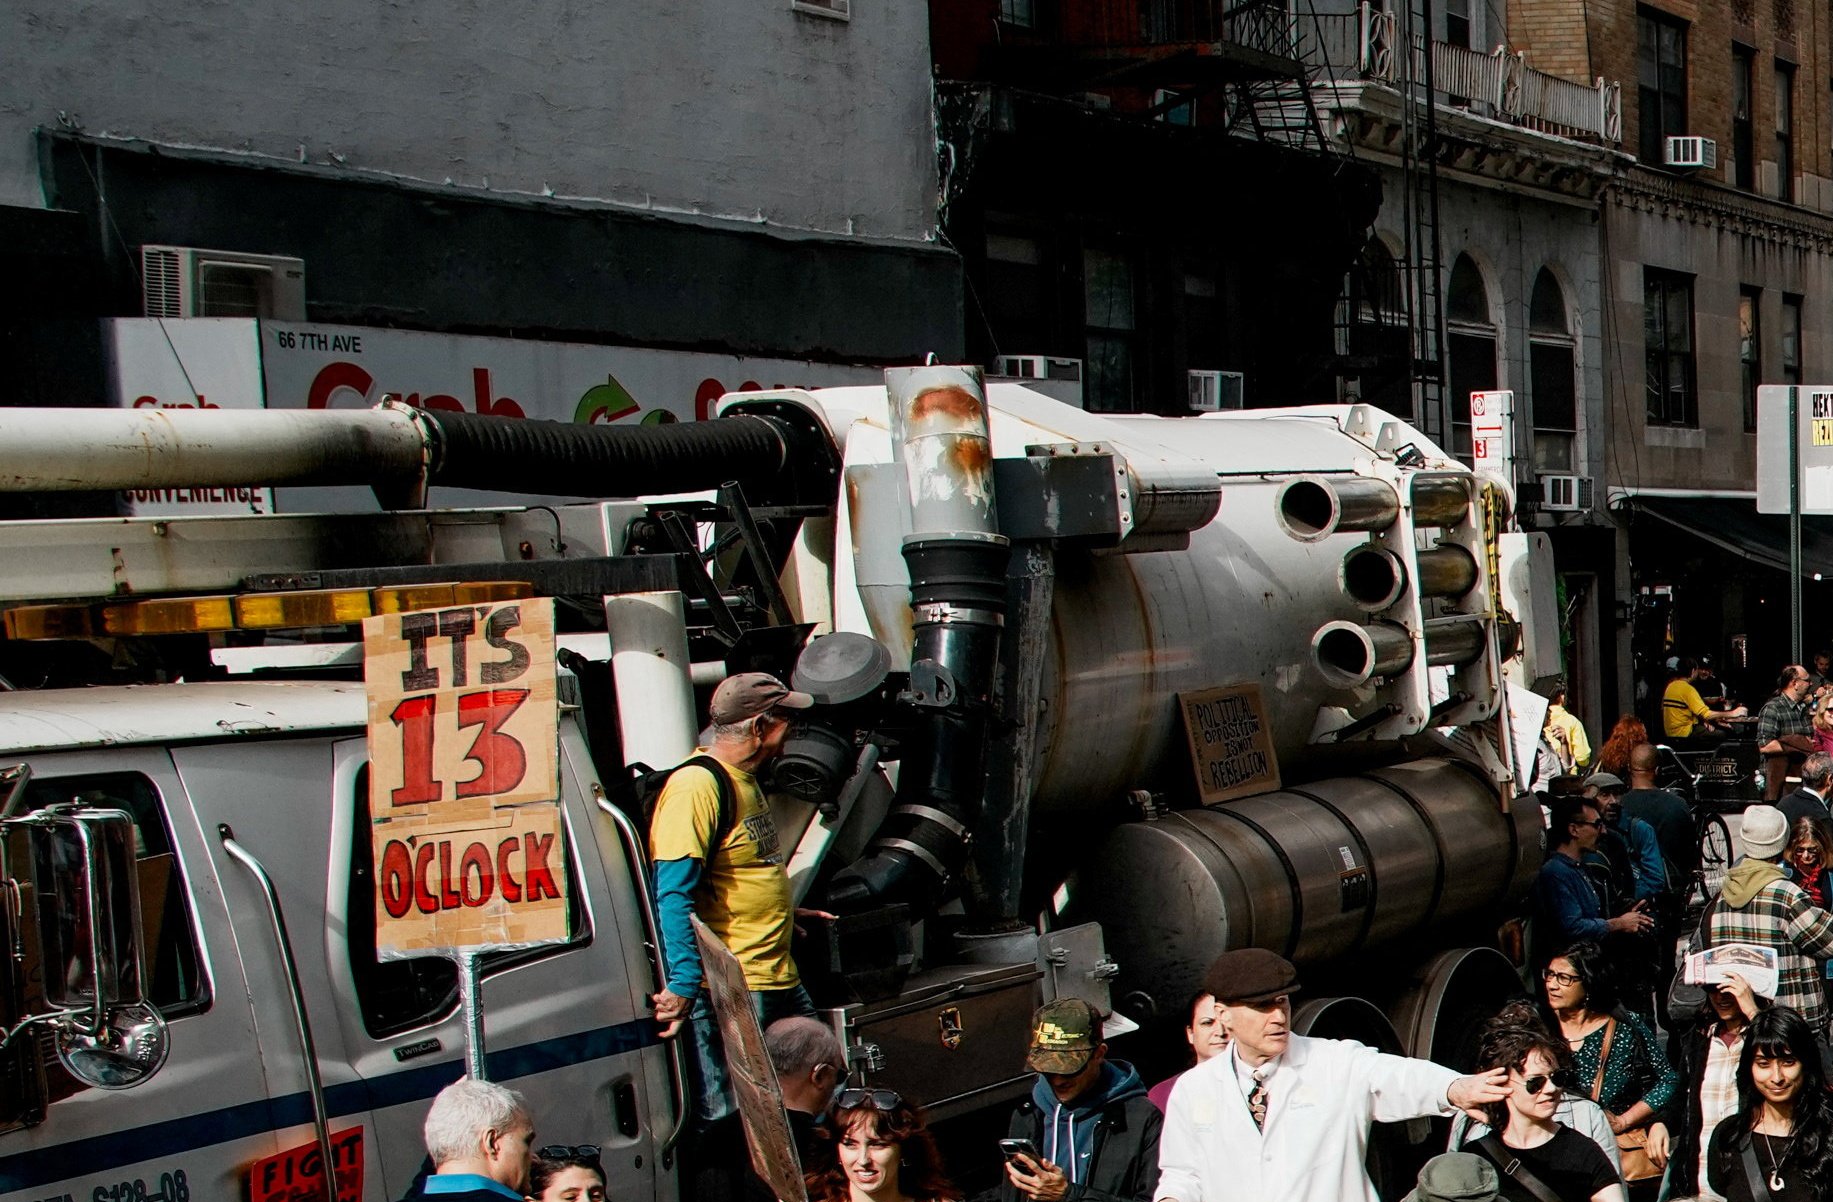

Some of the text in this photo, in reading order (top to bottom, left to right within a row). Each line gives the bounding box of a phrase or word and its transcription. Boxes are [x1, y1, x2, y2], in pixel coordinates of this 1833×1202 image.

[279, 331, 362, 353] 66 7TH AVE
[401, 605, 532, 692] IT'S
[1195, 695, 1258, 730] POLITICAL
[389, 688, 531, 807] 13
[1204, 720, 1260, 745] OPPOSITION
[1224, 737, 1254, 759] IS NOT
[1209, 750, 1268, 790] REBELLION
[381, 831, 562, 919] O'CLOCK
